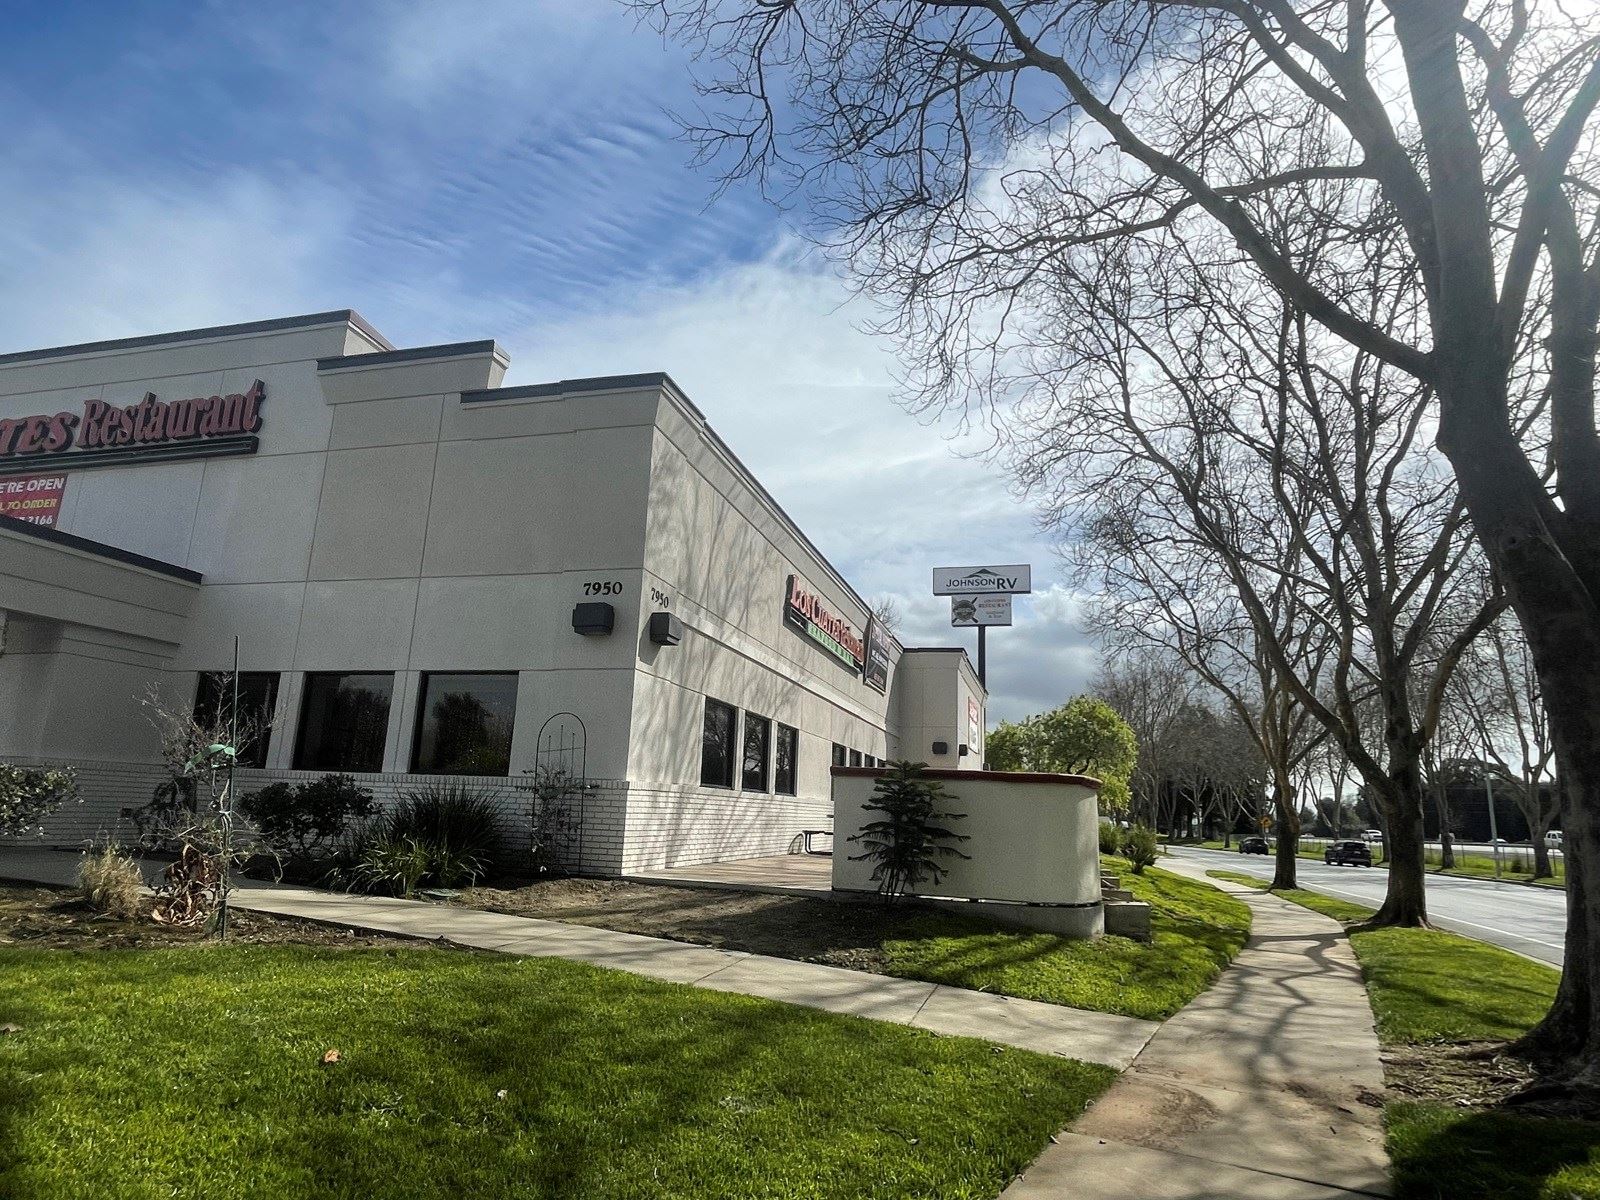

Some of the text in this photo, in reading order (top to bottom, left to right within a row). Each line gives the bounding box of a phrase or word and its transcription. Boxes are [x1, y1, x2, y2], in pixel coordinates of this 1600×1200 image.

[76, 379, 265, 448] Restaurant
[27, 478, 65, 491] OPEN
[7, 501, 21, 509] TO
[22, 499, 58, 509] ORDER
[583, 581, 623, 596] 7950
[946, 578, 1018, 589] JOHNSON RV
[651, 587, 669, 608] 7950
